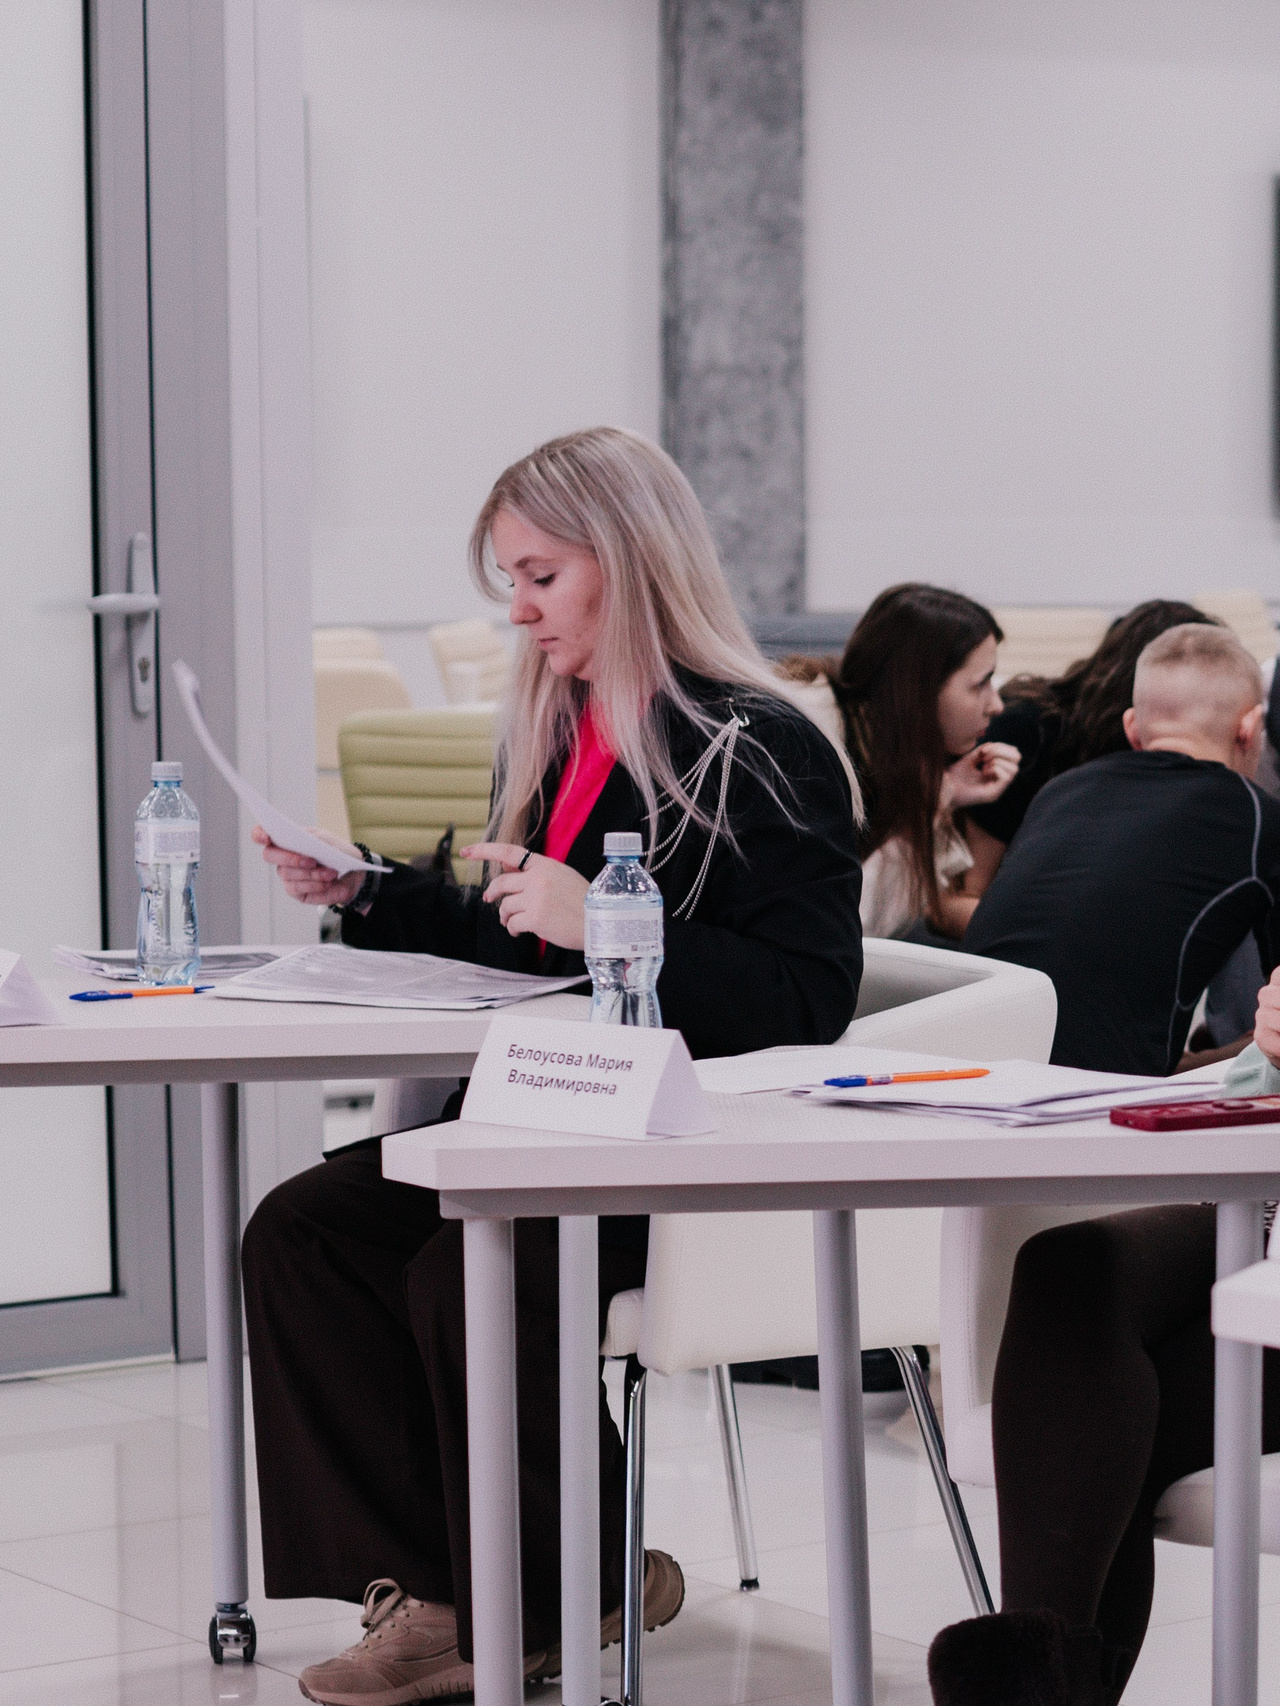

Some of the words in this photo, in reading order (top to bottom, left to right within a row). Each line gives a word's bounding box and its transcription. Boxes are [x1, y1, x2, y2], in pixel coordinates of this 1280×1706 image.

[507, 1043, 583, 1067] Белоусова
[585, 1053, 633, 1073] Мария
[507, 1069, 617, 1095] Владимировна
